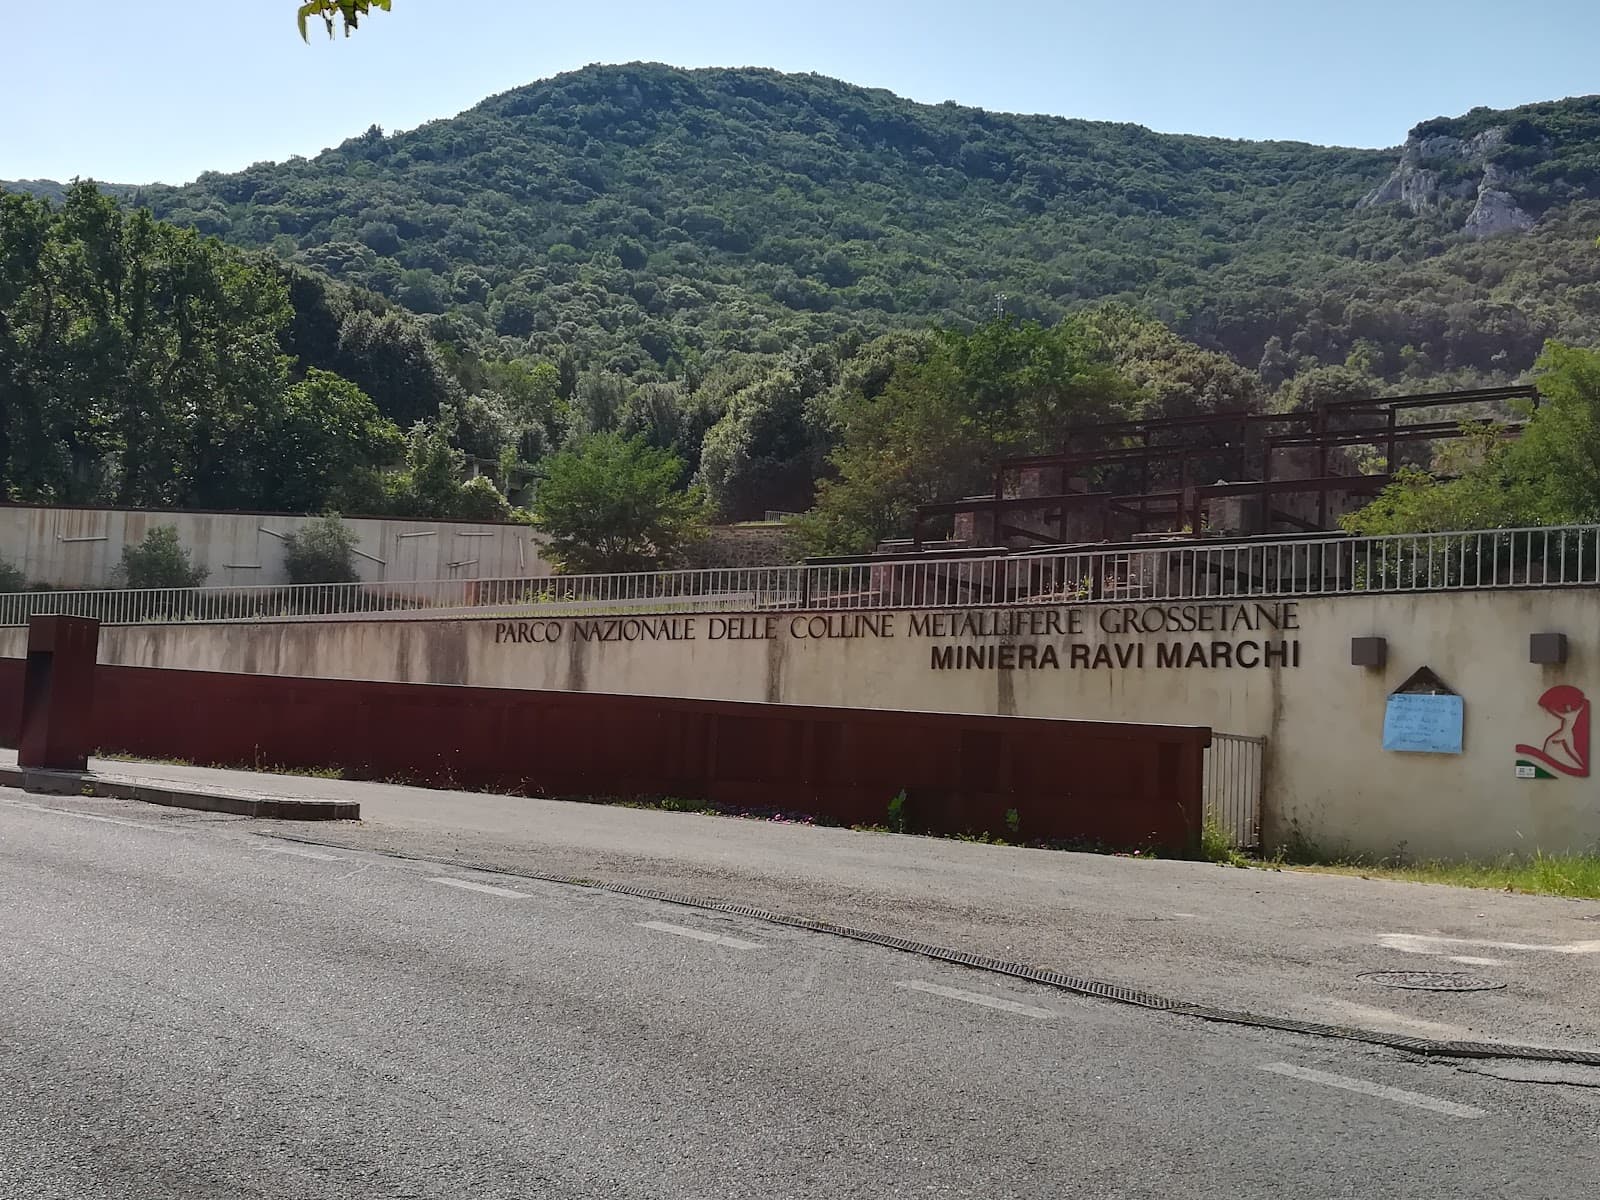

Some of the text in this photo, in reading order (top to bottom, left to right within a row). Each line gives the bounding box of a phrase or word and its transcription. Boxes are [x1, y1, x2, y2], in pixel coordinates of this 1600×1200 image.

[495, 602, 1300, 643] PARCO NAZIONALE DELLE COLLINE METALLIFERE GROSSETANE
[931, 640, 1300, 670] MINIERA RAVI MARCHI
